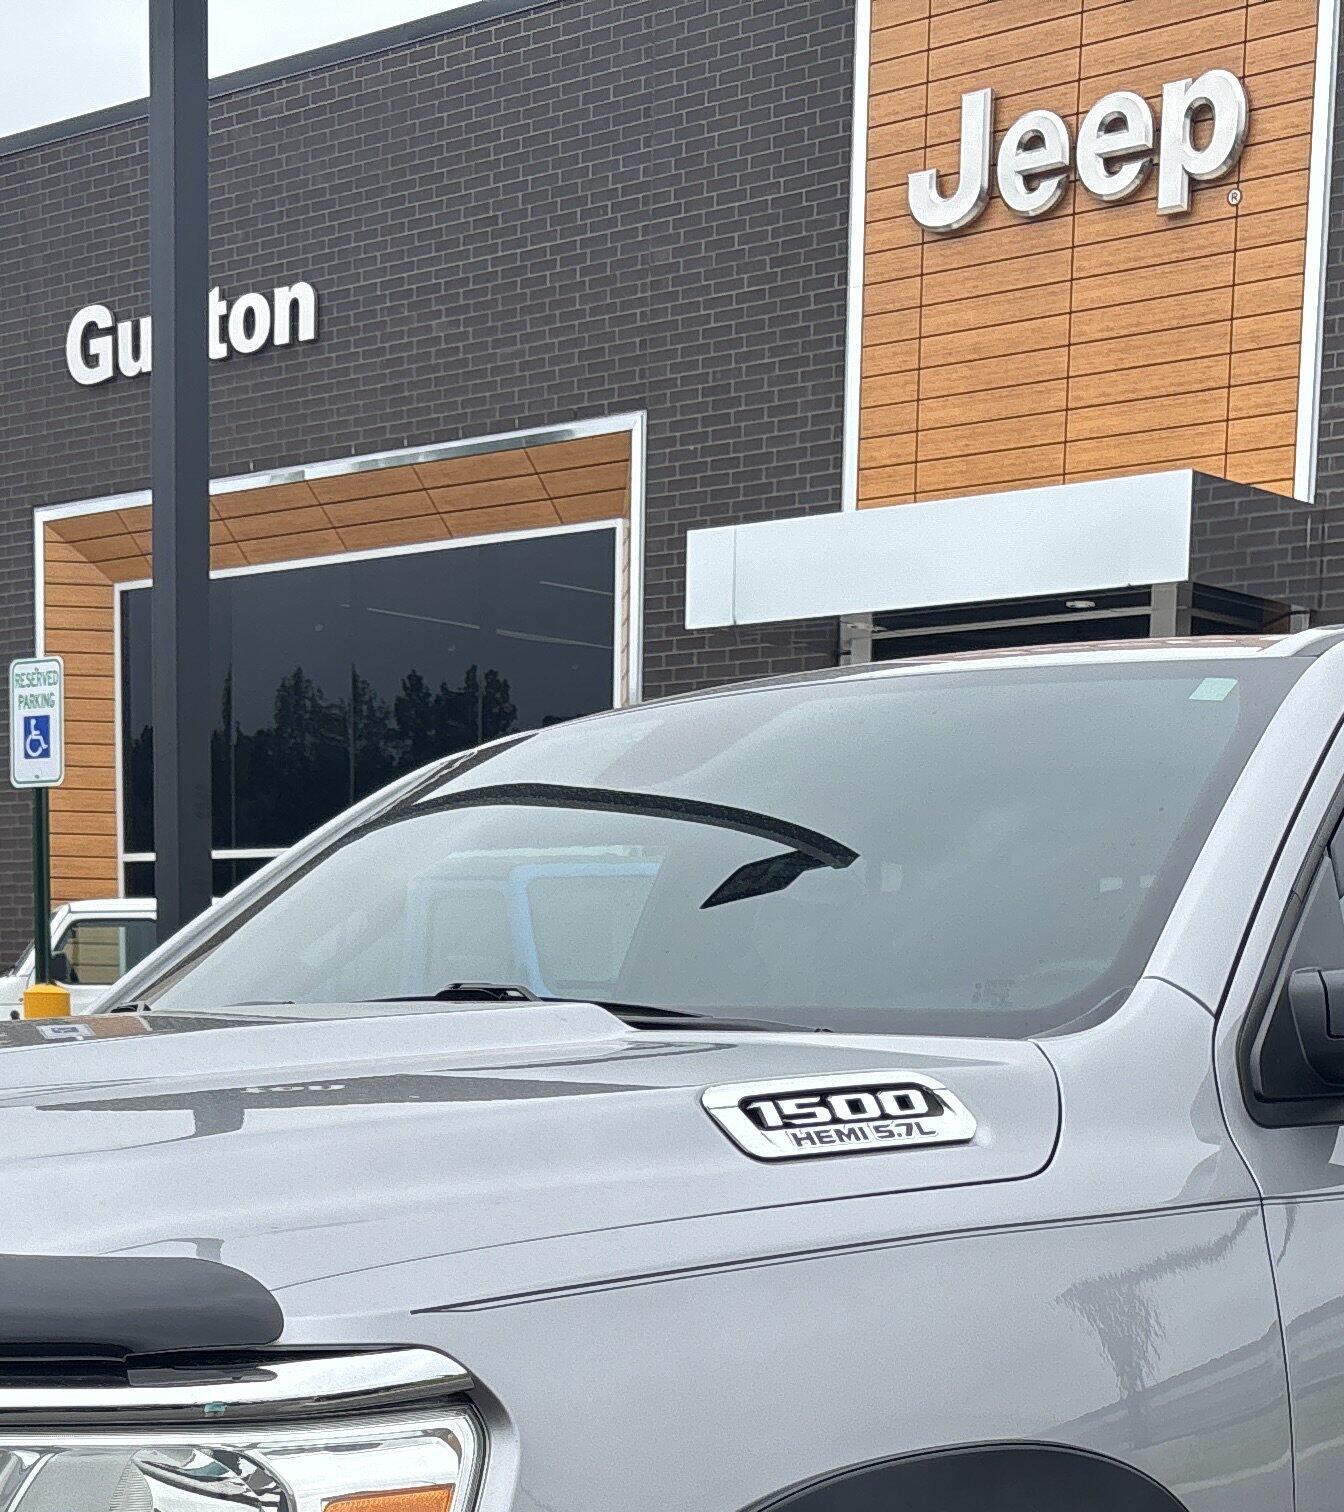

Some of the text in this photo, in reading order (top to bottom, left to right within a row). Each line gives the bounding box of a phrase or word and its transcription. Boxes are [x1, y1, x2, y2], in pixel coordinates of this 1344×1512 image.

[907, 69, 1249, 234] Jeep
[66, 281, 318, 385] Guton
[15, 669, 59, 688] RESERVED
[18, 692, 55, 710] PARKING
[745, 1088, 934, 1128] 1500
[792, 1121, 937, 1148] HEMI 5.7L
